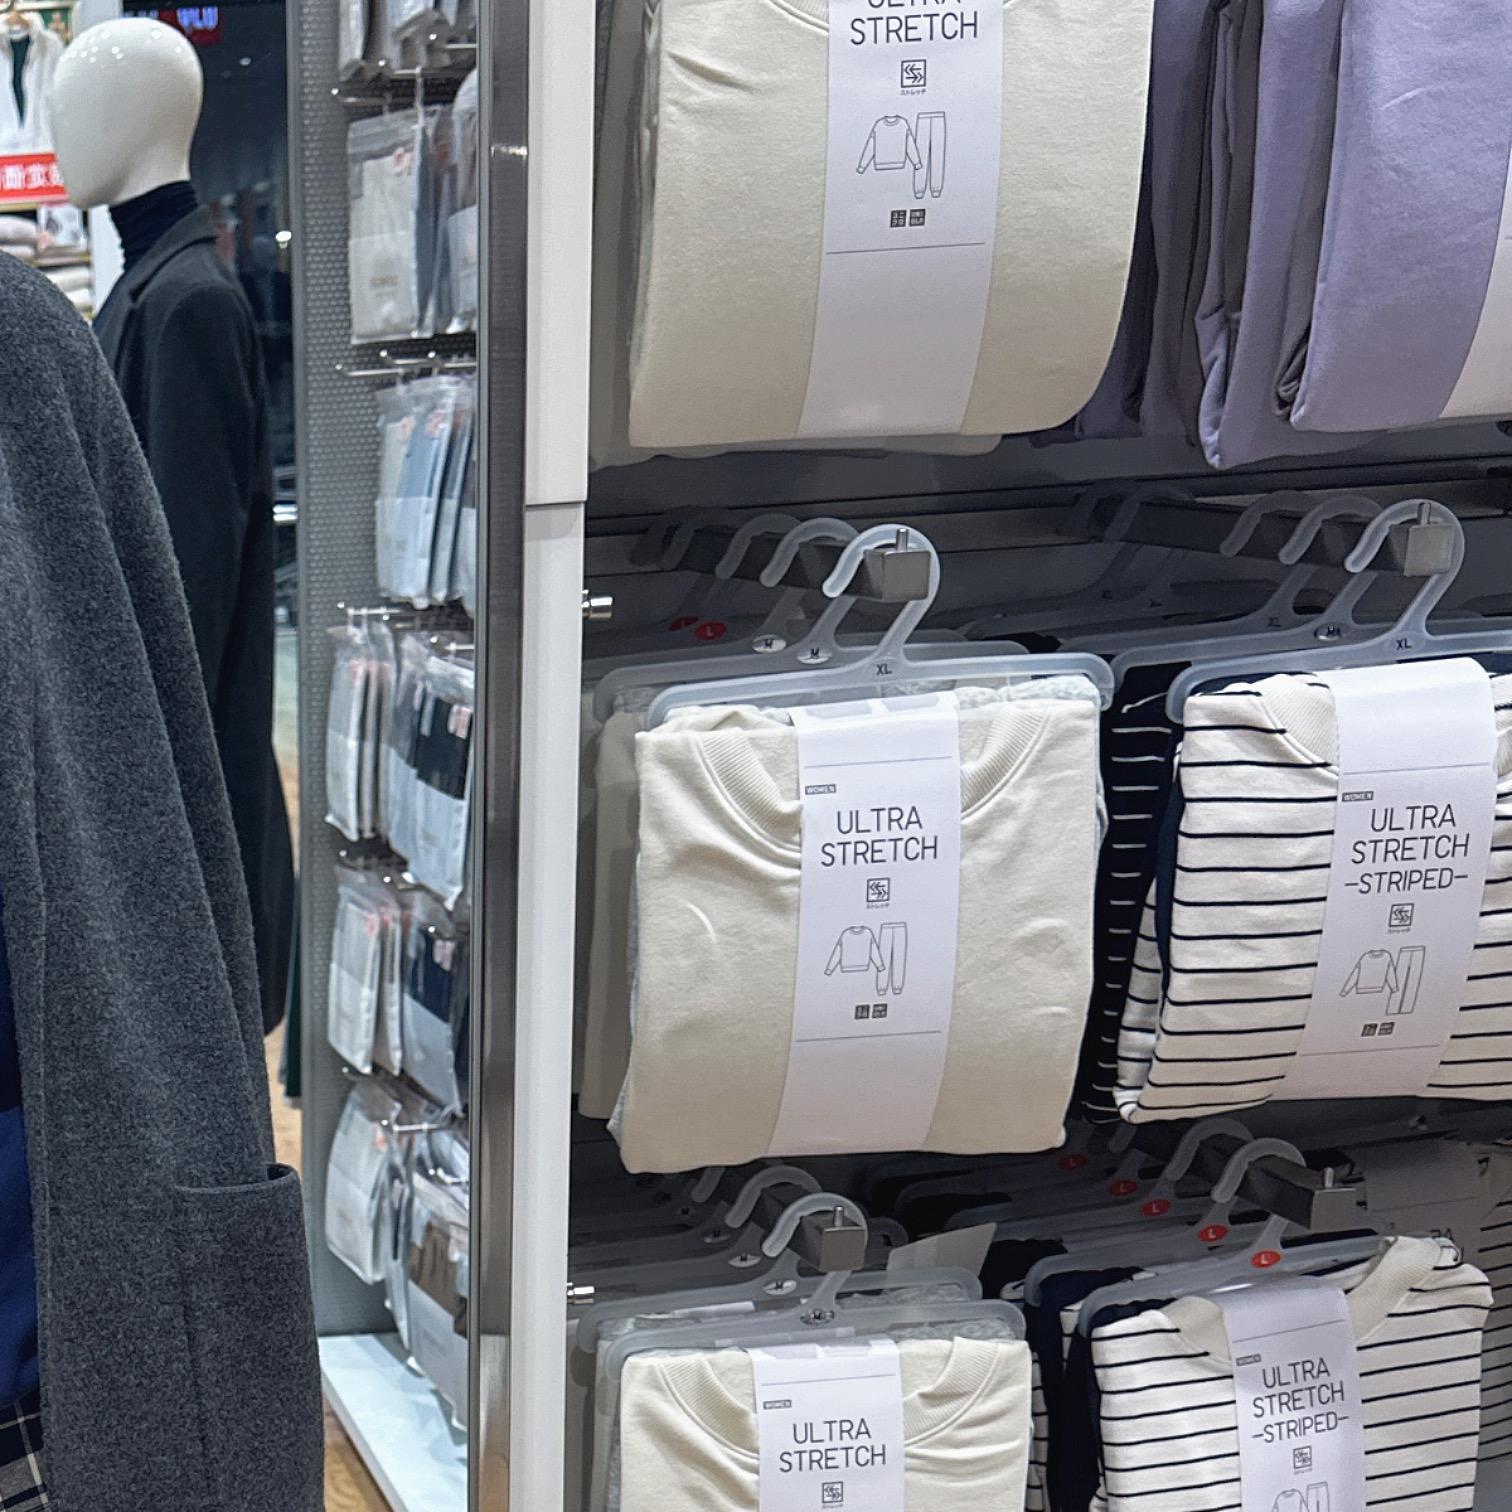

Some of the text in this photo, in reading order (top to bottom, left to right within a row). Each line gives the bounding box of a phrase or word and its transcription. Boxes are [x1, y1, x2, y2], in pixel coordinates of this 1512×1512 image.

[850, 11, 978, 45] STRETCH
[1396, 638, 1412, 650] XL
[876, 663, 892, 675] XL
[836, 806, 923, 834] ULTRA
[1370, 804, 1456, 832] ULTRA
[821, 836, 938, 867] STRETCH
[1351, 833, 1470, 864] STRETCH
[1262, 1357, 1331, 1389] ULTRA
[1253, 1380, 1345, 1418] STRETCH
[792, 1418, 872, 1444] ULTRA
[779, 1444, 887, 1473] STRETCH
